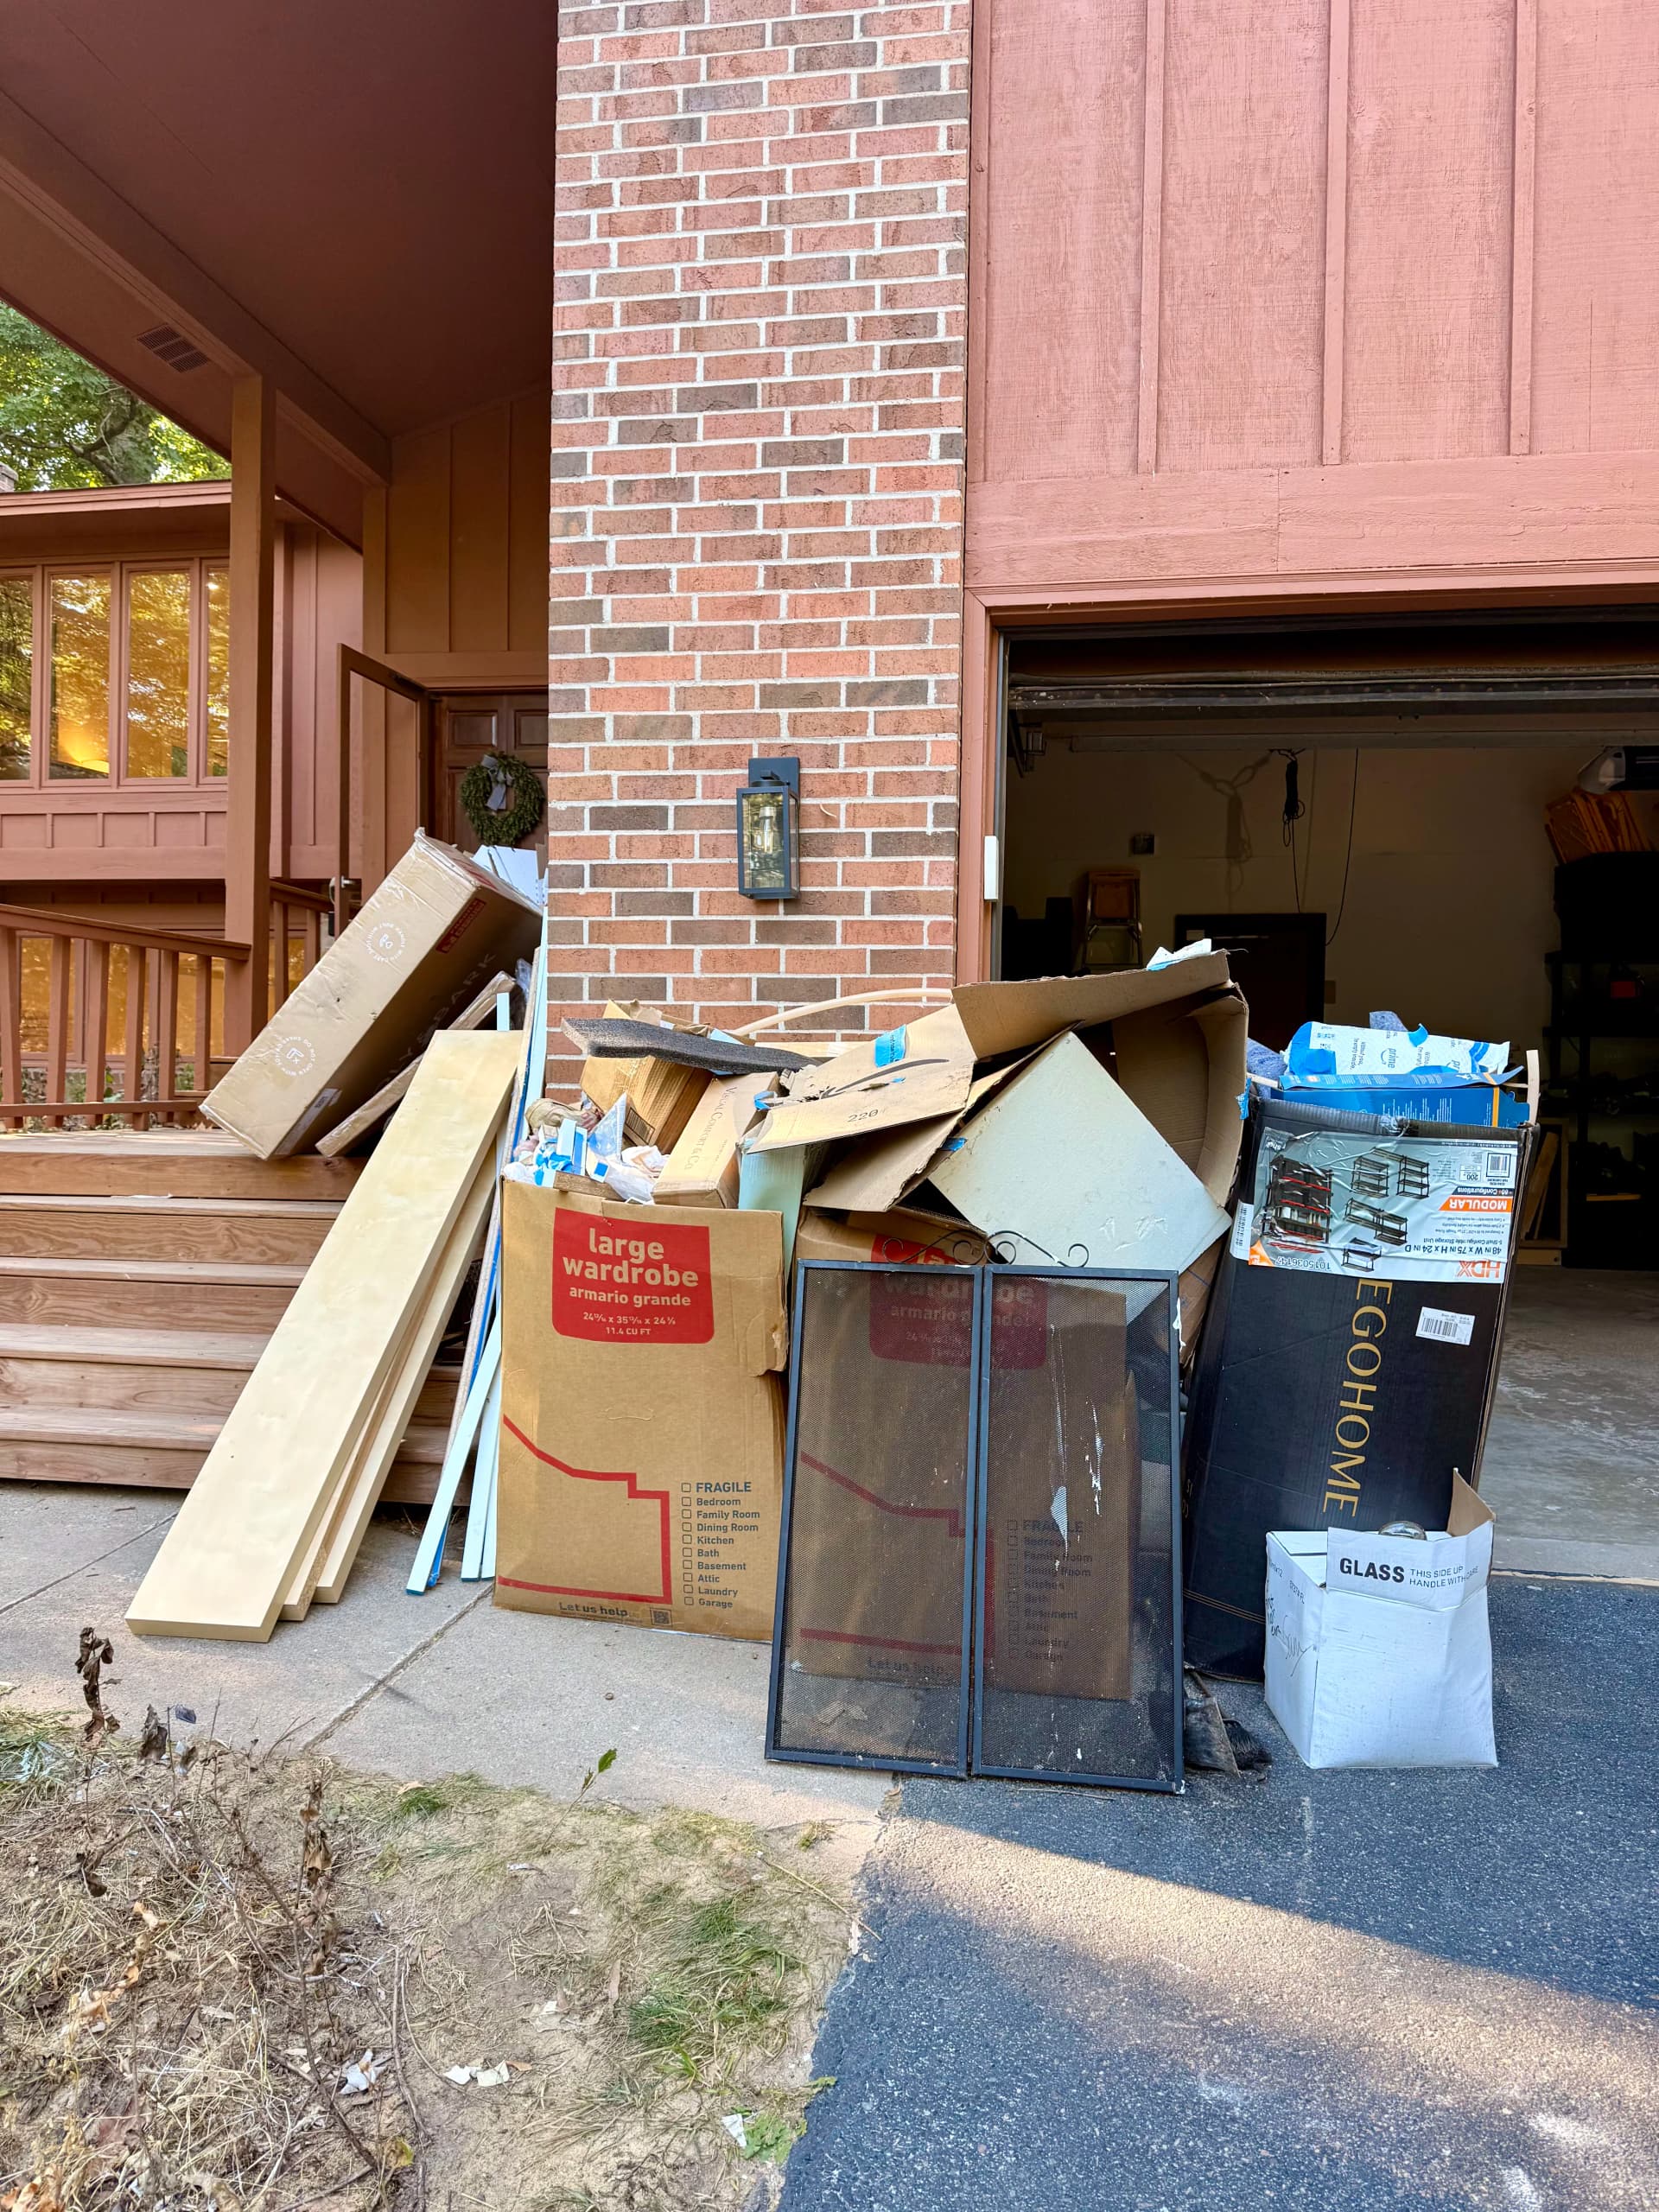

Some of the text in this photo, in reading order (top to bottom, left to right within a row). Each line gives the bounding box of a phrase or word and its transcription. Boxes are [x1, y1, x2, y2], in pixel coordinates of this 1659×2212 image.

[1386, 1047, 1396, 1069] prime
[848, 1109, 879, 1122] 220
[1449, 1198, 1507, 1210] MODULAR
[589, 1228, 664, 1264] large
[1422, 1244, 1433, 1253] 24
[1457, 1245, 1467, 1254] 75
[1474, 1246, 1484, 1255] W
[1492, 1246, 1502, 1255] 48
[563, 1257, 698, 1287] wardrobe
[1457, 1259, 1501, 1279] HDX
[569, 1287, 691, 1307] armario grande
[606, 1326, 624, 1335] 11.4
[1322, 1278, 1393, 1517] EGOHOME
[696, 1481, 752, 1493] FRAGILE
[696, 1497, 741, 1506] Bedroom
[696, 1510, 760, 1521] Family Room
[696, 1523, 759, 1534] Dining Room
[696, 1535, 734, 1545] Kitchen
[697, 1548, 720, 1558] Bath
[697, 1561, 747, 1571] Basement
[1339, 1557, 1405, 1584] GLASS
[697, 1573, 721, 1583] Attic
[1410, 1566, 1464, 1579] THIS SIDE UP
[1409, 1579, 1446, 1588] HANDLE
[1447, 1576, 1466, 1586] WITH
[698, 1586, 738, 1598] Laundry
[698, 1598, 734, 1609] Garage
[558, 1602, 579, 1611] Let
[600, 1605, 629, 1618] help
